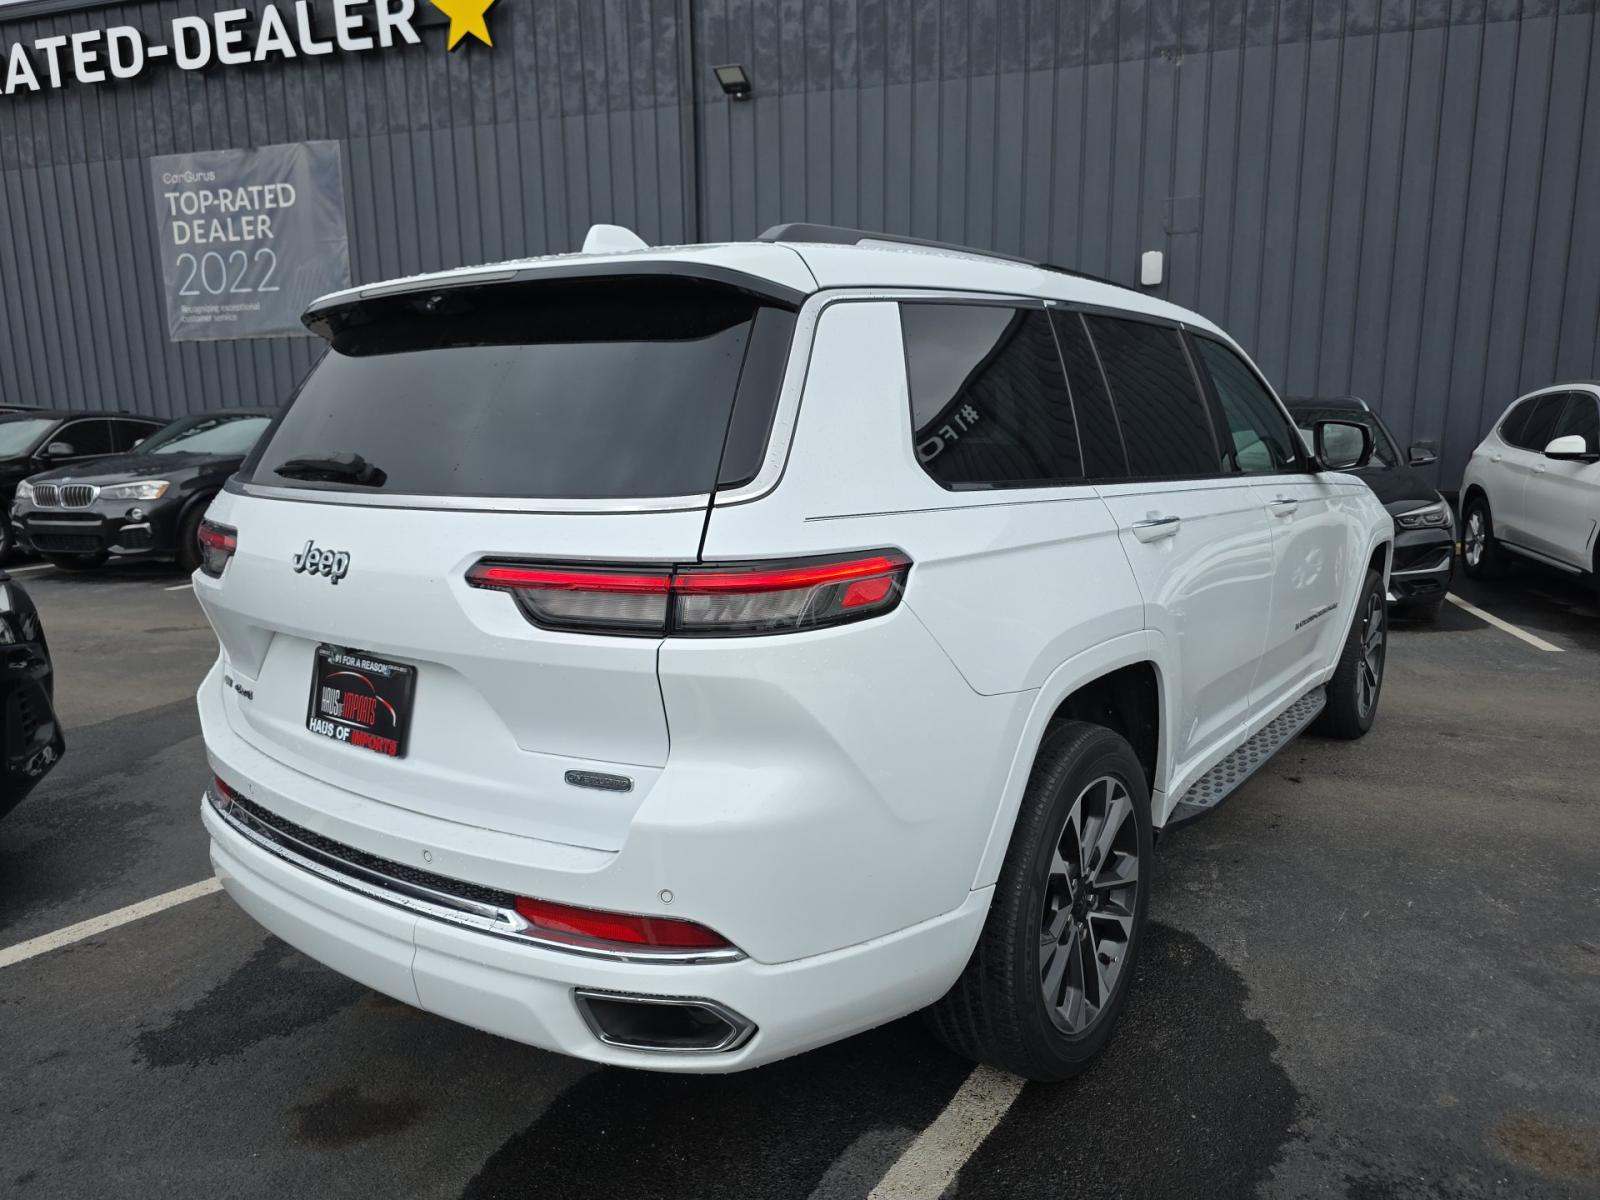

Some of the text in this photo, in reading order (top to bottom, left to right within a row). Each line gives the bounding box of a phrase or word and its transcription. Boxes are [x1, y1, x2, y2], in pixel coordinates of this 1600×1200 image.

[0, 0, 421, 95] ATED-DEALER
[162, 170, 216, 185] CarGurus
[164, 183, 296, 216] TOP-RATED
[172, 214, 274, 245] DEALER
[176, 248, 280, 296] 2022
[292, 540, 351, 585] Jeep
[343, 655, 355, 667] FOR
[361, 659, 387, 675] REASON
[309, 717, 334, 737] HAUS
[336, 726, 351, 741] OF
